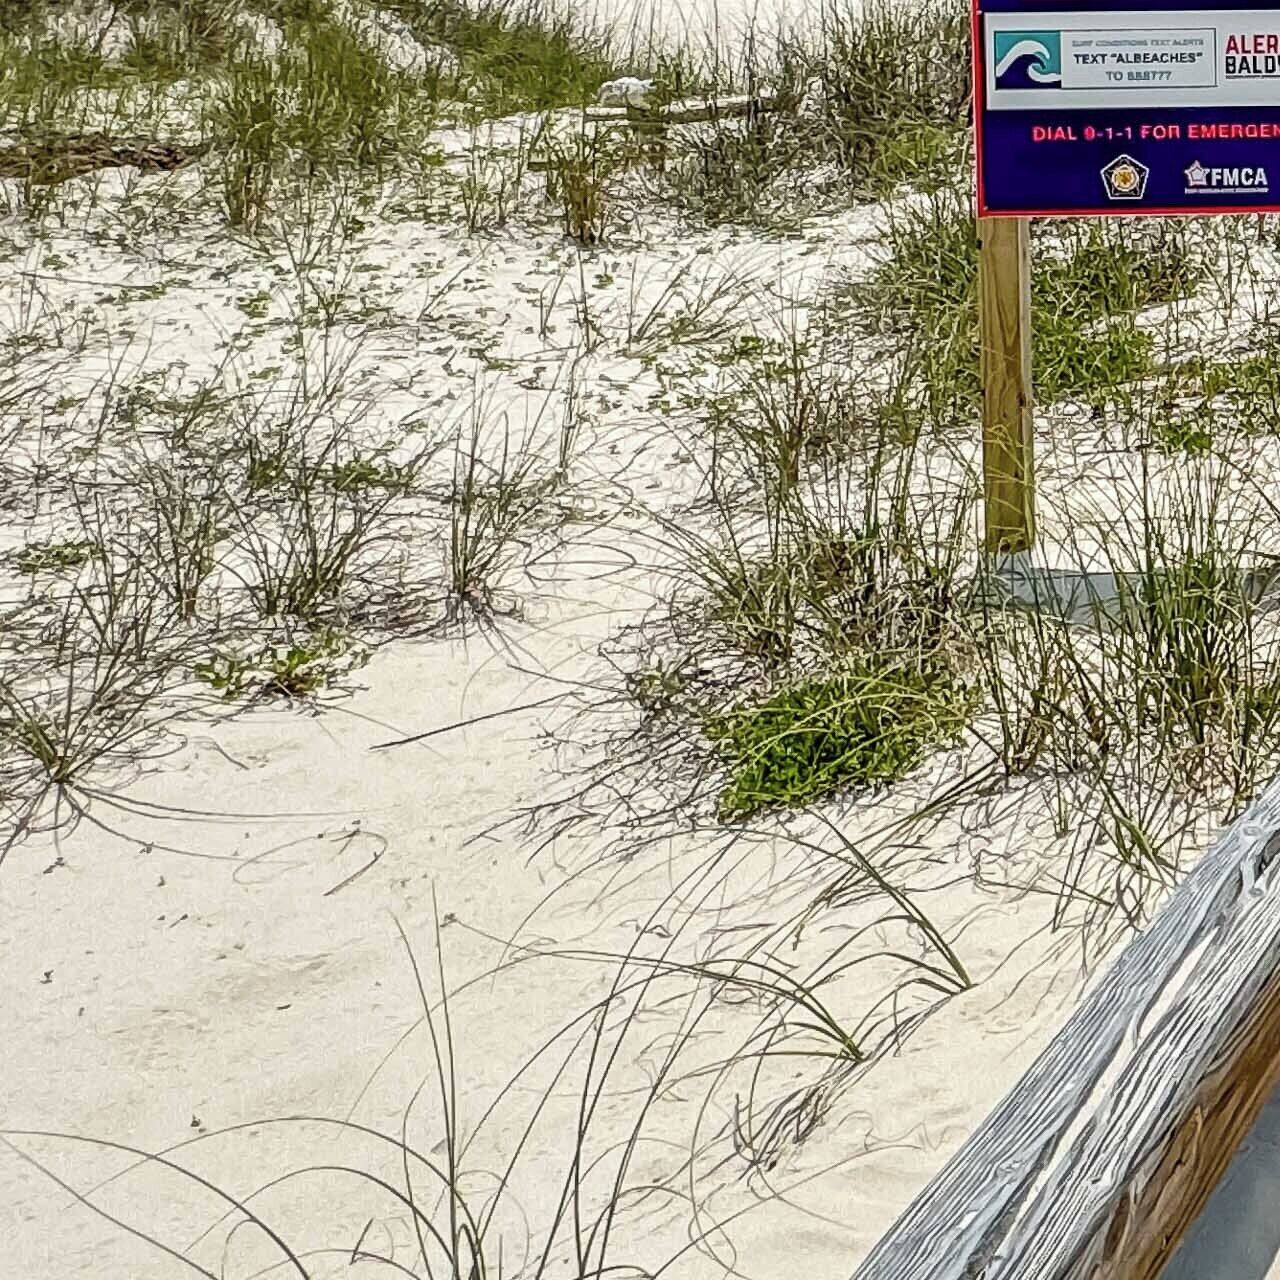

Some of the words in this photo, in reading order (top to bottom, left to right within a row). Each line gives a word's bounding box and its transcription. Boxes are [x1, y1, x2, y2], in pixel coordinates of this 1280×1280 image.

[1073, 53, 1107, 65] TEXT
[1106, 71, 1124, 81] TO
[1127, 70, 1172, 81] 888777
[1032, 125, 1078, 141] DIAL
[1141, 124, 1181, 140] FOR
[1210, 167, 1269, 187] FMCA
